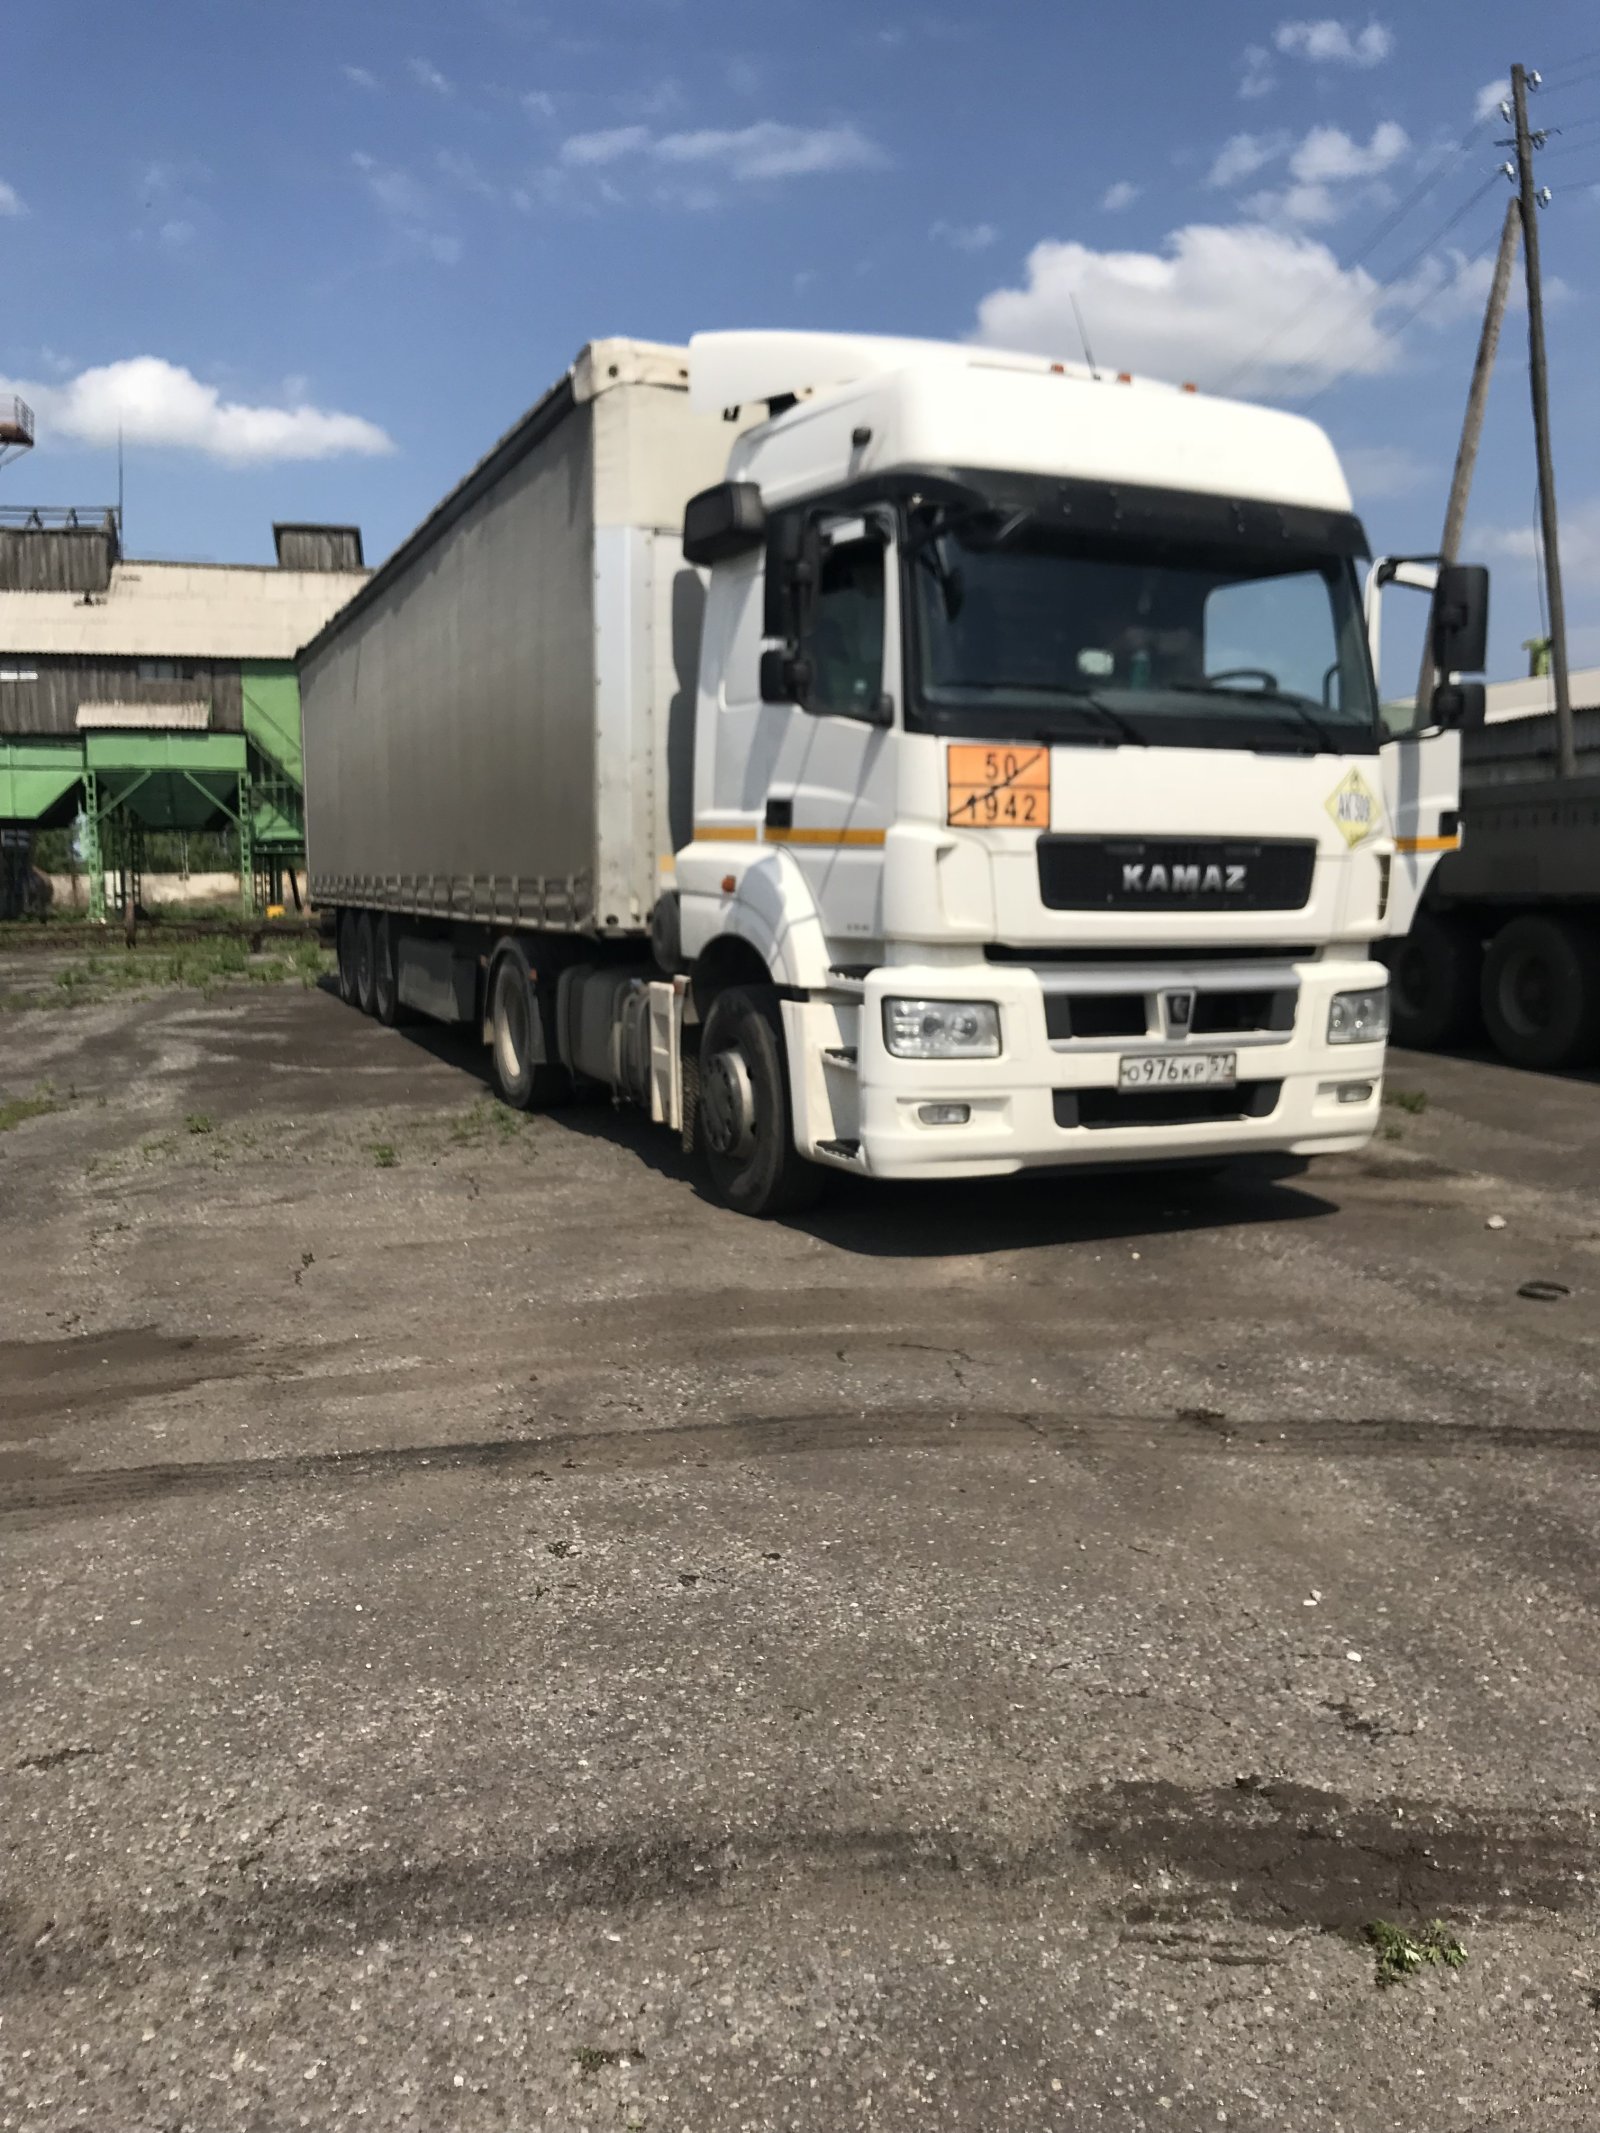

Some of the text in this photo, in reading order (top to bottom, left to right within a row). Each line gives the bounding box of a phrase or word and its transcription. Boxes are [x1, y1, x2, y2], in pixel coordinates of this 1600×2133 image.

[985, 752, 1018, 781] 50
[966, 793, 1036, 821] 1942
[1122, 863, 1247, 892] KAMAZ
